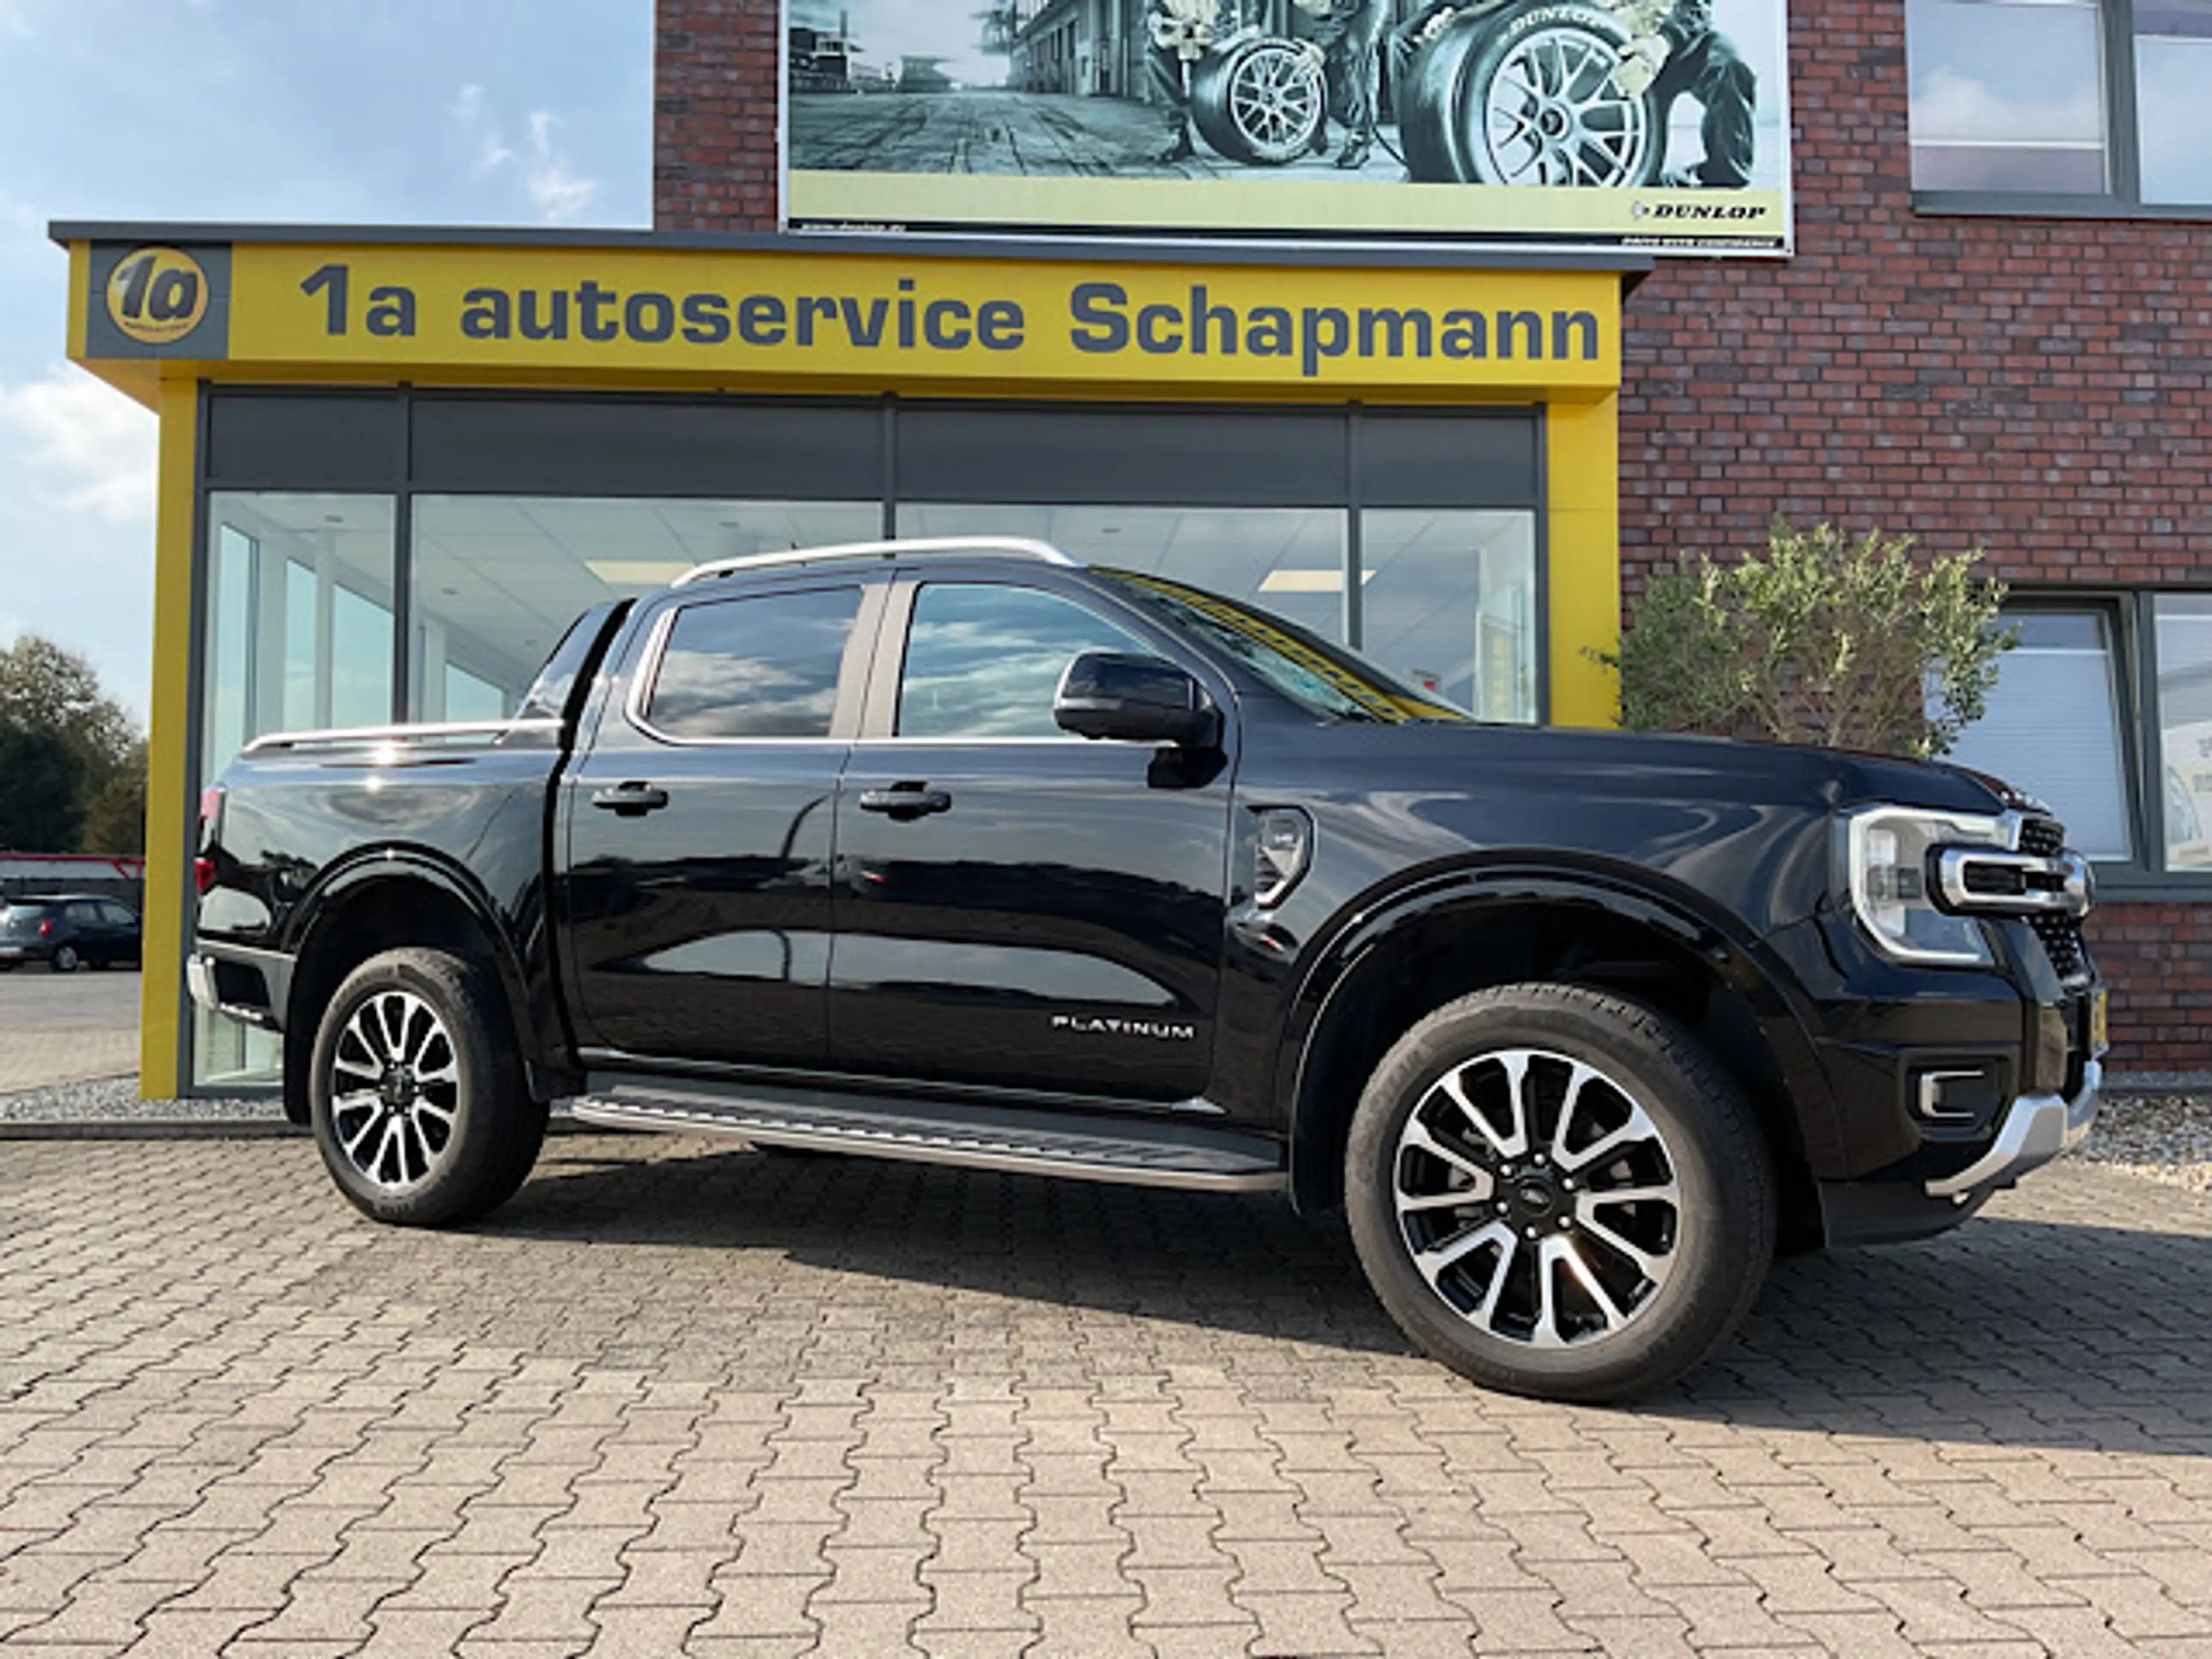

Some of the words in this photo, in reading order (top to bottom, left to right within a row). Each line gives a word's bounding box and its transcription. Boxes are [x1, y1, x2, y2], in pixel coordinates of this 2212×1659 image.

[1653, 203, 1767, 219] DUNLOP
[301, 264, 415, 336] 1a
[461, 279, 1024, 350] autoservice
[1071, 283, 1597, 376] Schapmann
[1051, 1015, 1195, 1039] PLATINUM
